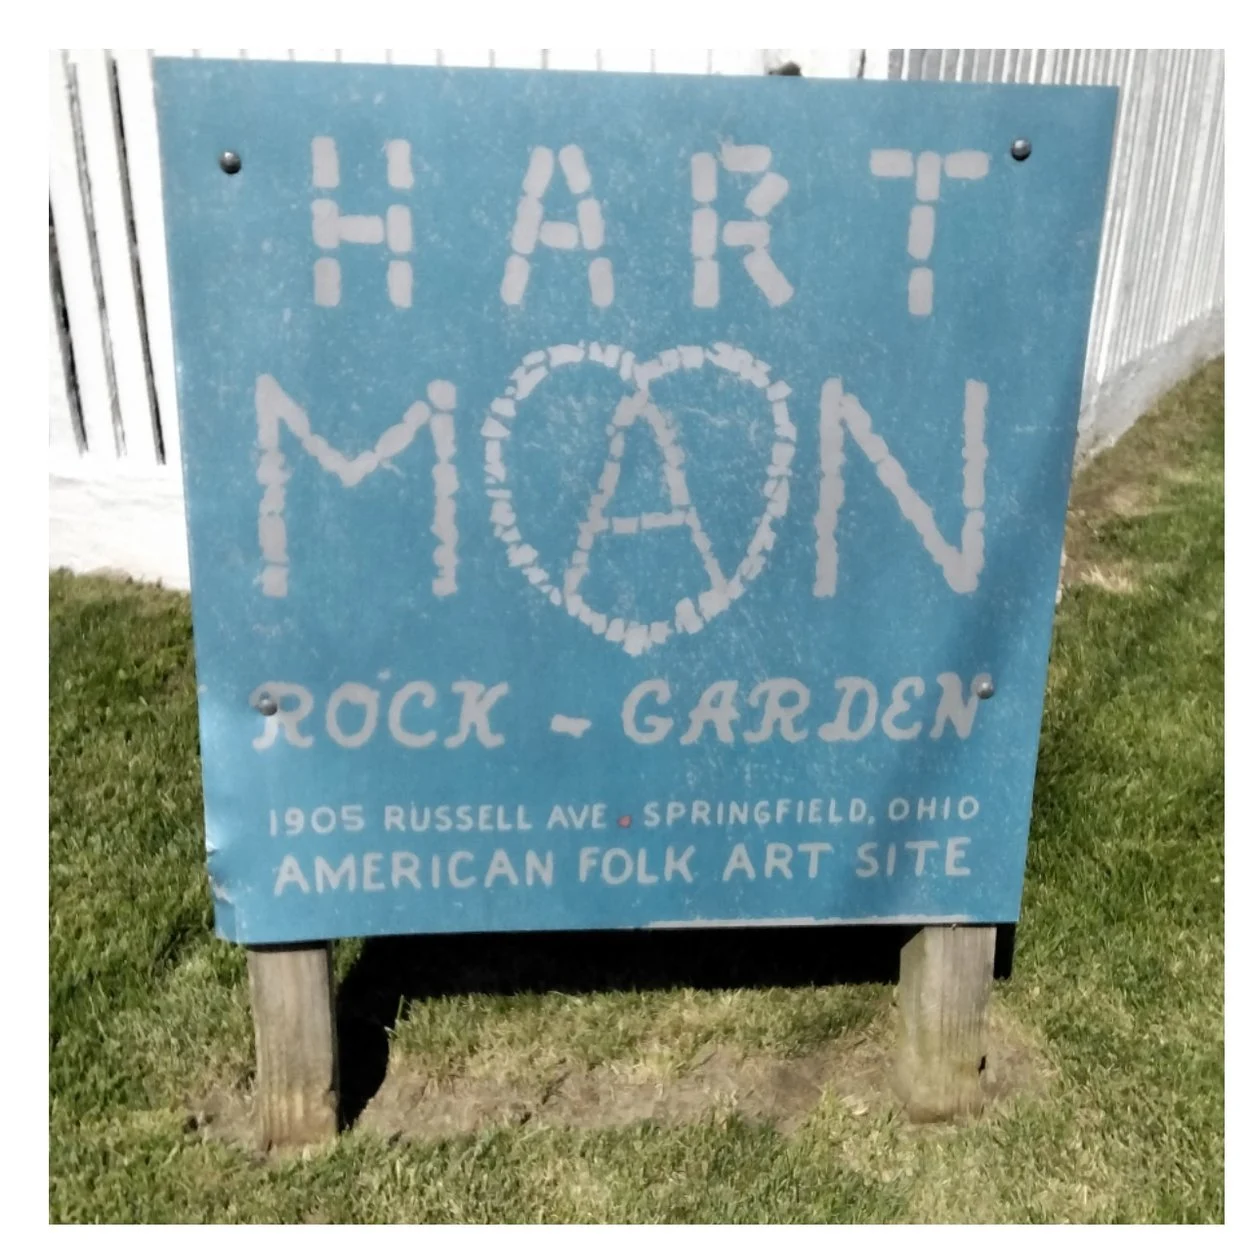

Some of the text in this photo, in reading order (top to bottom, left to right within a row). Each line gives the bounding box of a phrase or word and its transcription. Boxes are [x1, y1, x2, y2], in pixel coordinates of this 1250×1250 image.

[311, 136, 989, 316] HART
[255, 373, 989, 602] MAN
[251, 680, 510, 750] ROCK
[622, 673, 984, 744] GARDEN
[269, 795, 979, 835] 1905 RUSSELL AVE SPRINGFIELD, OHIO
[273, 837, 972, 895] AMERICAN FOLK ART SITE
